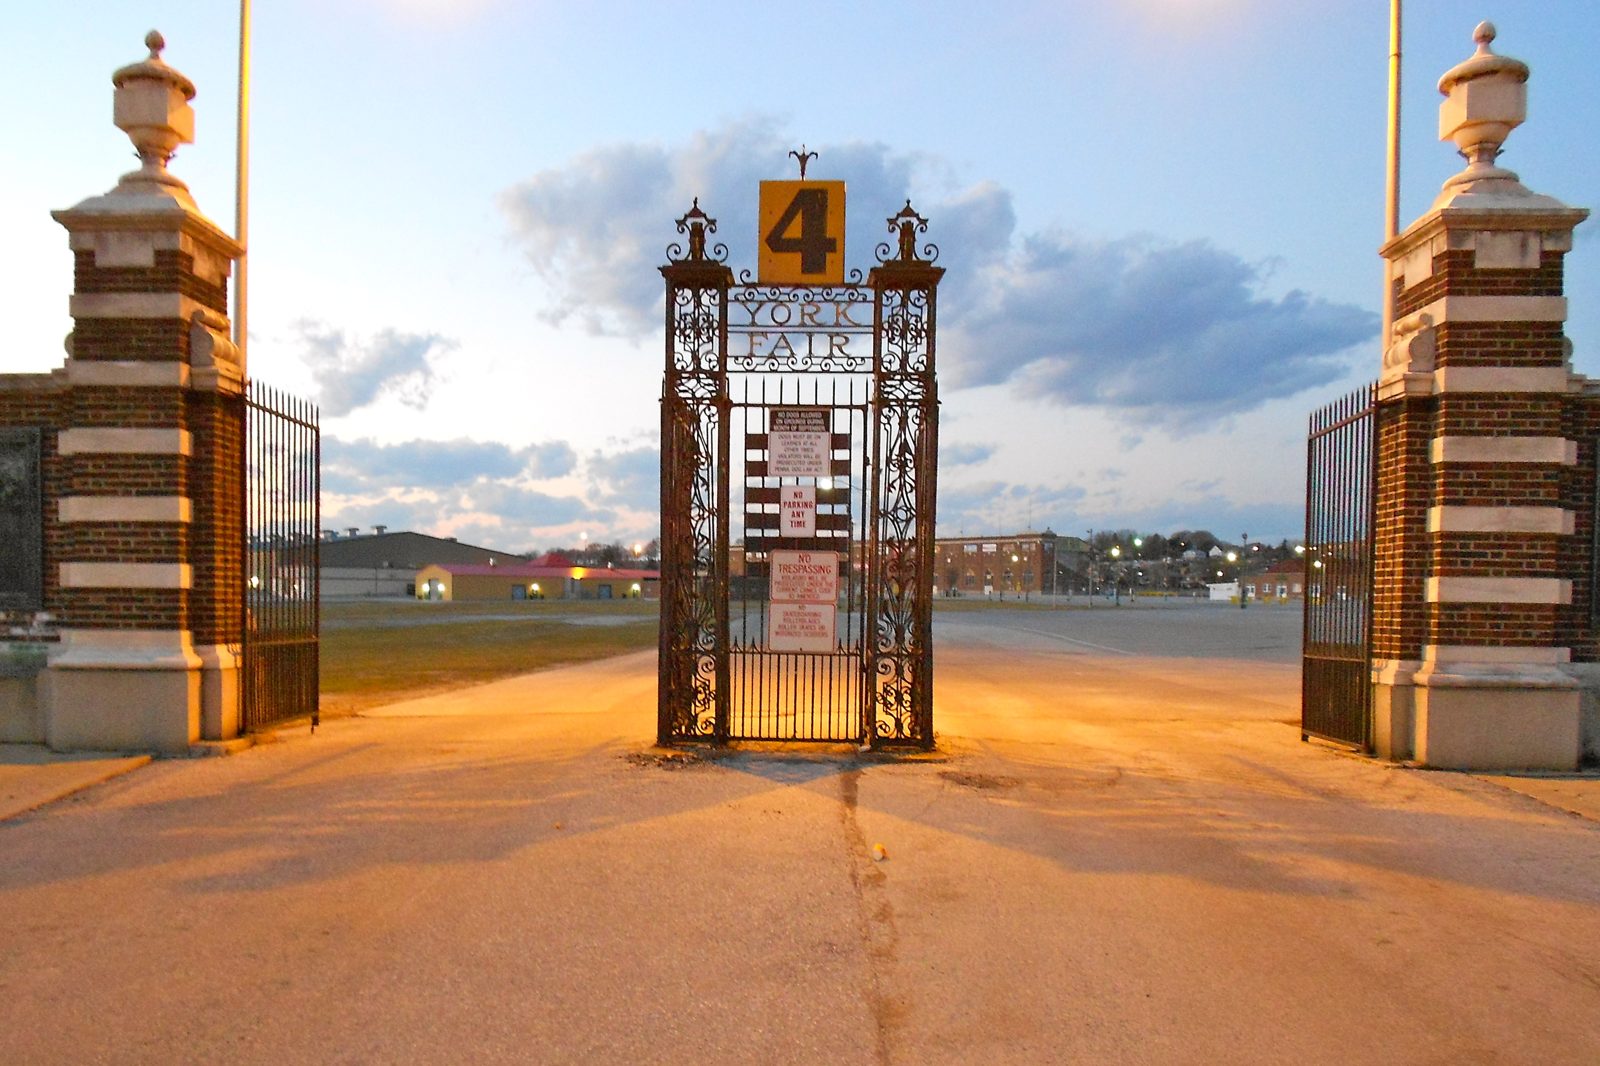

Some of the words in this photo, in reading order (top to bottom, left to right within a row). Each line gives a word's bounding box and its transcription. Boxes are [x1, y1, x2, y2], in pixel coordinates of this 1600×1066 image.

[765, 188, 837, 274] 4
[740, 301, 862, 327] YORK
[748, 332, 852, 357] FAIR
[793, 491, 803, 500] NO
[783, 500, 814, 510] PARKING
[791, 510, 805, 519] ANY
[790, 520, 807, 529] TIME
[798, 553, 811, 563] NO
[779, 564, 832, 574] TRESPASSING
